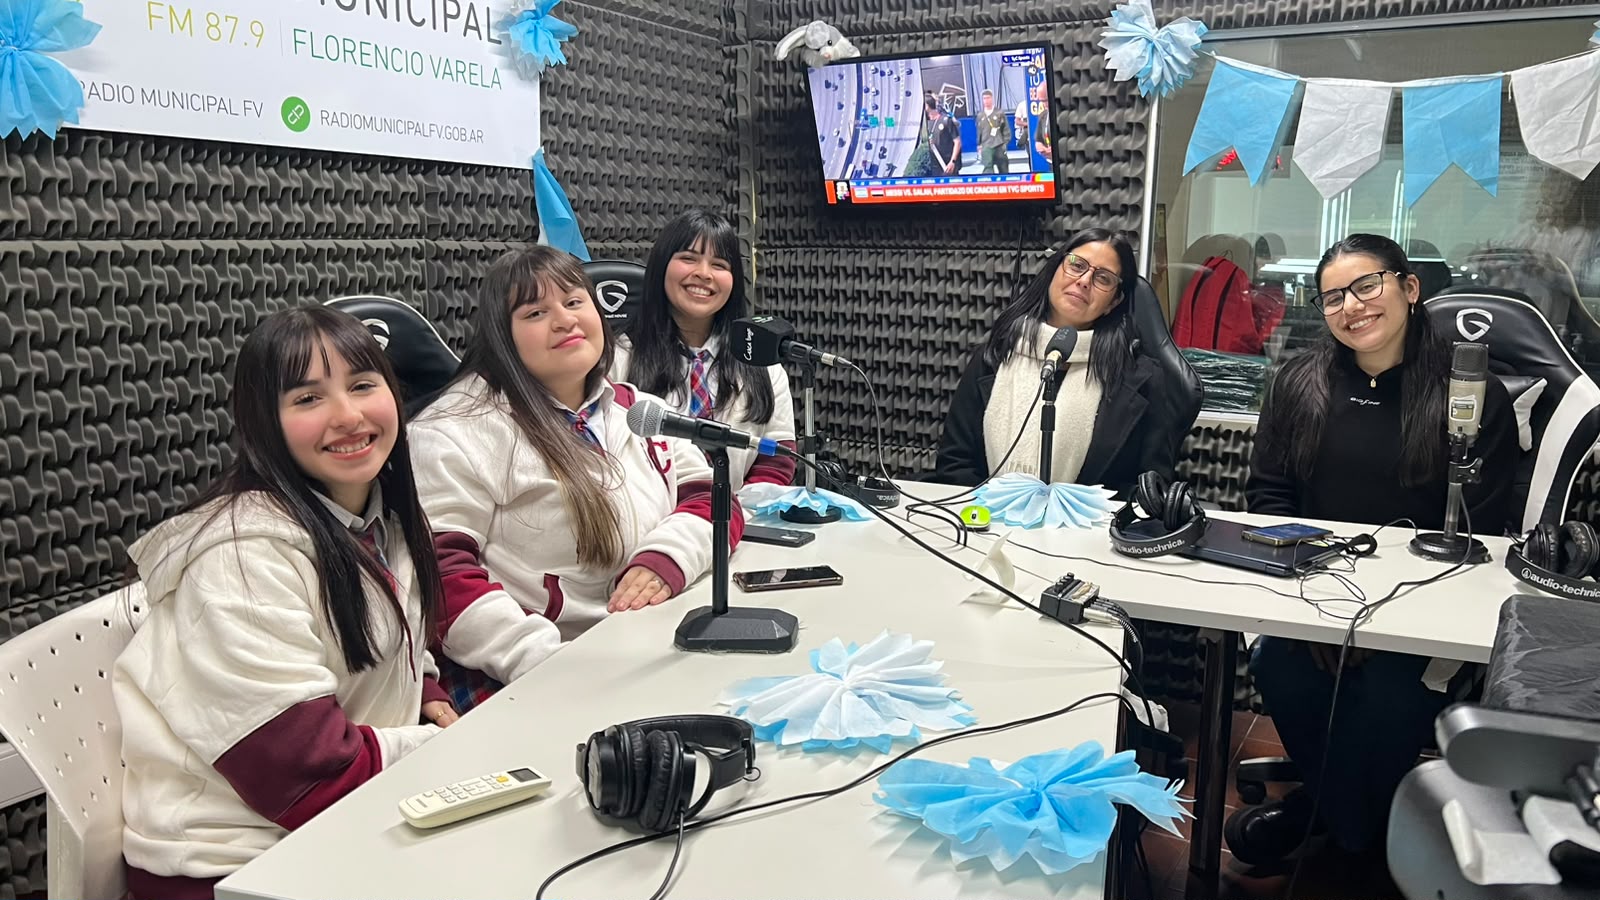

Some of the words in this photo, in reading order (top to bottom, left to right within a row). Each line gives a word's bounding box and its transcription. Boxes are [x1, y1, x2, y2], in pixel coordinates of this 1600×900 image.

[147, 1, 194, 37] FM
[205, 12, 265, 48] 87.9
[319, 0, 503, 45] ICIPAL
[293, 28, 424, 76] FLORENCIO
[429, 54, 502, 90] VARELA
[141, 87, 239, 116] MUNICIPAL
[243, 100, 264, 118] FV
[320, 110, 484, 144] RADIOMUNICIPALFV.GOB.AR
[933, 186, 965, 196] PARTIDAZO
[974, 185, 998, 194] CRACKS
[1020, 184, 1045, 193] SPORTS
[1530, 572, 1600, 598] audio-technic
